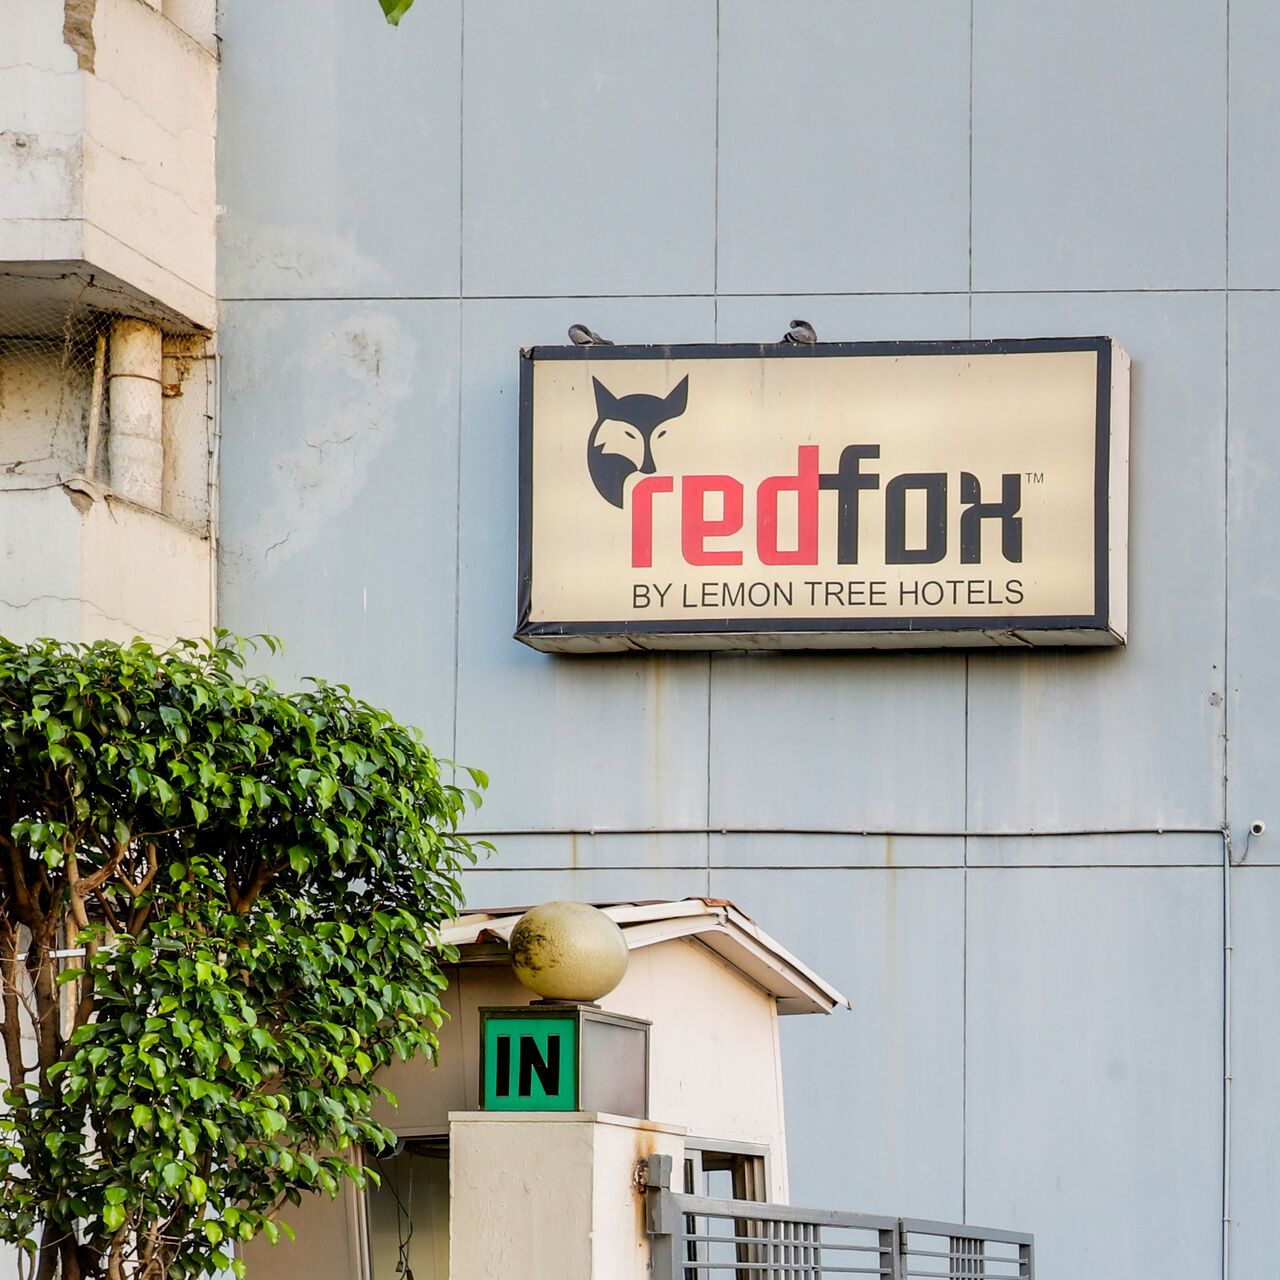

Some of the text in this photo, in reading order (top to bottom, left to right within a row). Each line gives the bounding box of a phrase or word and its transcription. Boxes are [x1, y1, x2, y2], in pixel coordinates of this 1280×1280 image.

[633, 579, 1024, 608] BY LEMON TREE HOTELS
[496, 1035, 560, 1097] IN
